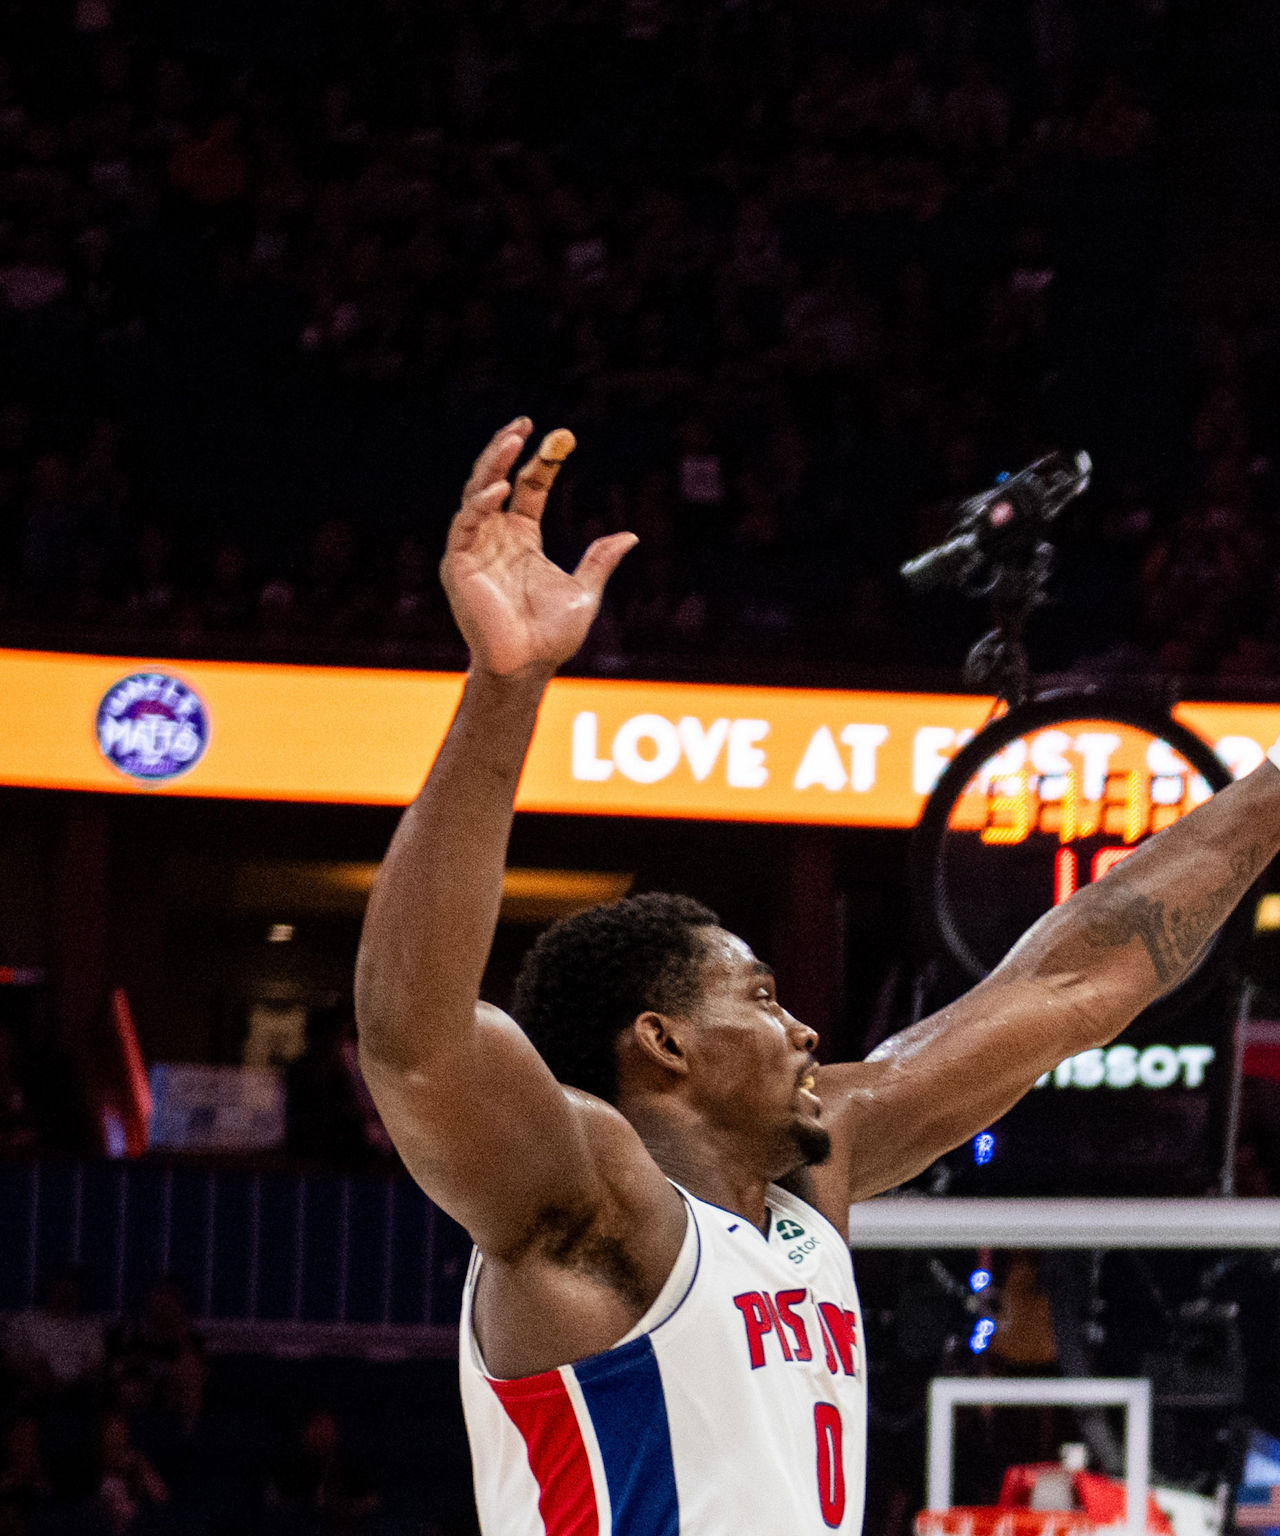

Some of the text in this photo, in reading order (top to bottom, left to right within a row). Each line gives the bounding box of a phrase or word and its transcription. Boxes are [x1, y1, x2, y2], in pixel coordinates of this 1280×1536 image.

[571, 710, 770, 790] LOVE
[793, 723, 890, 793] AT
[1034, 1044, 1216, 1090] ISSOT
[813, 1401, 845, 1530] 0
